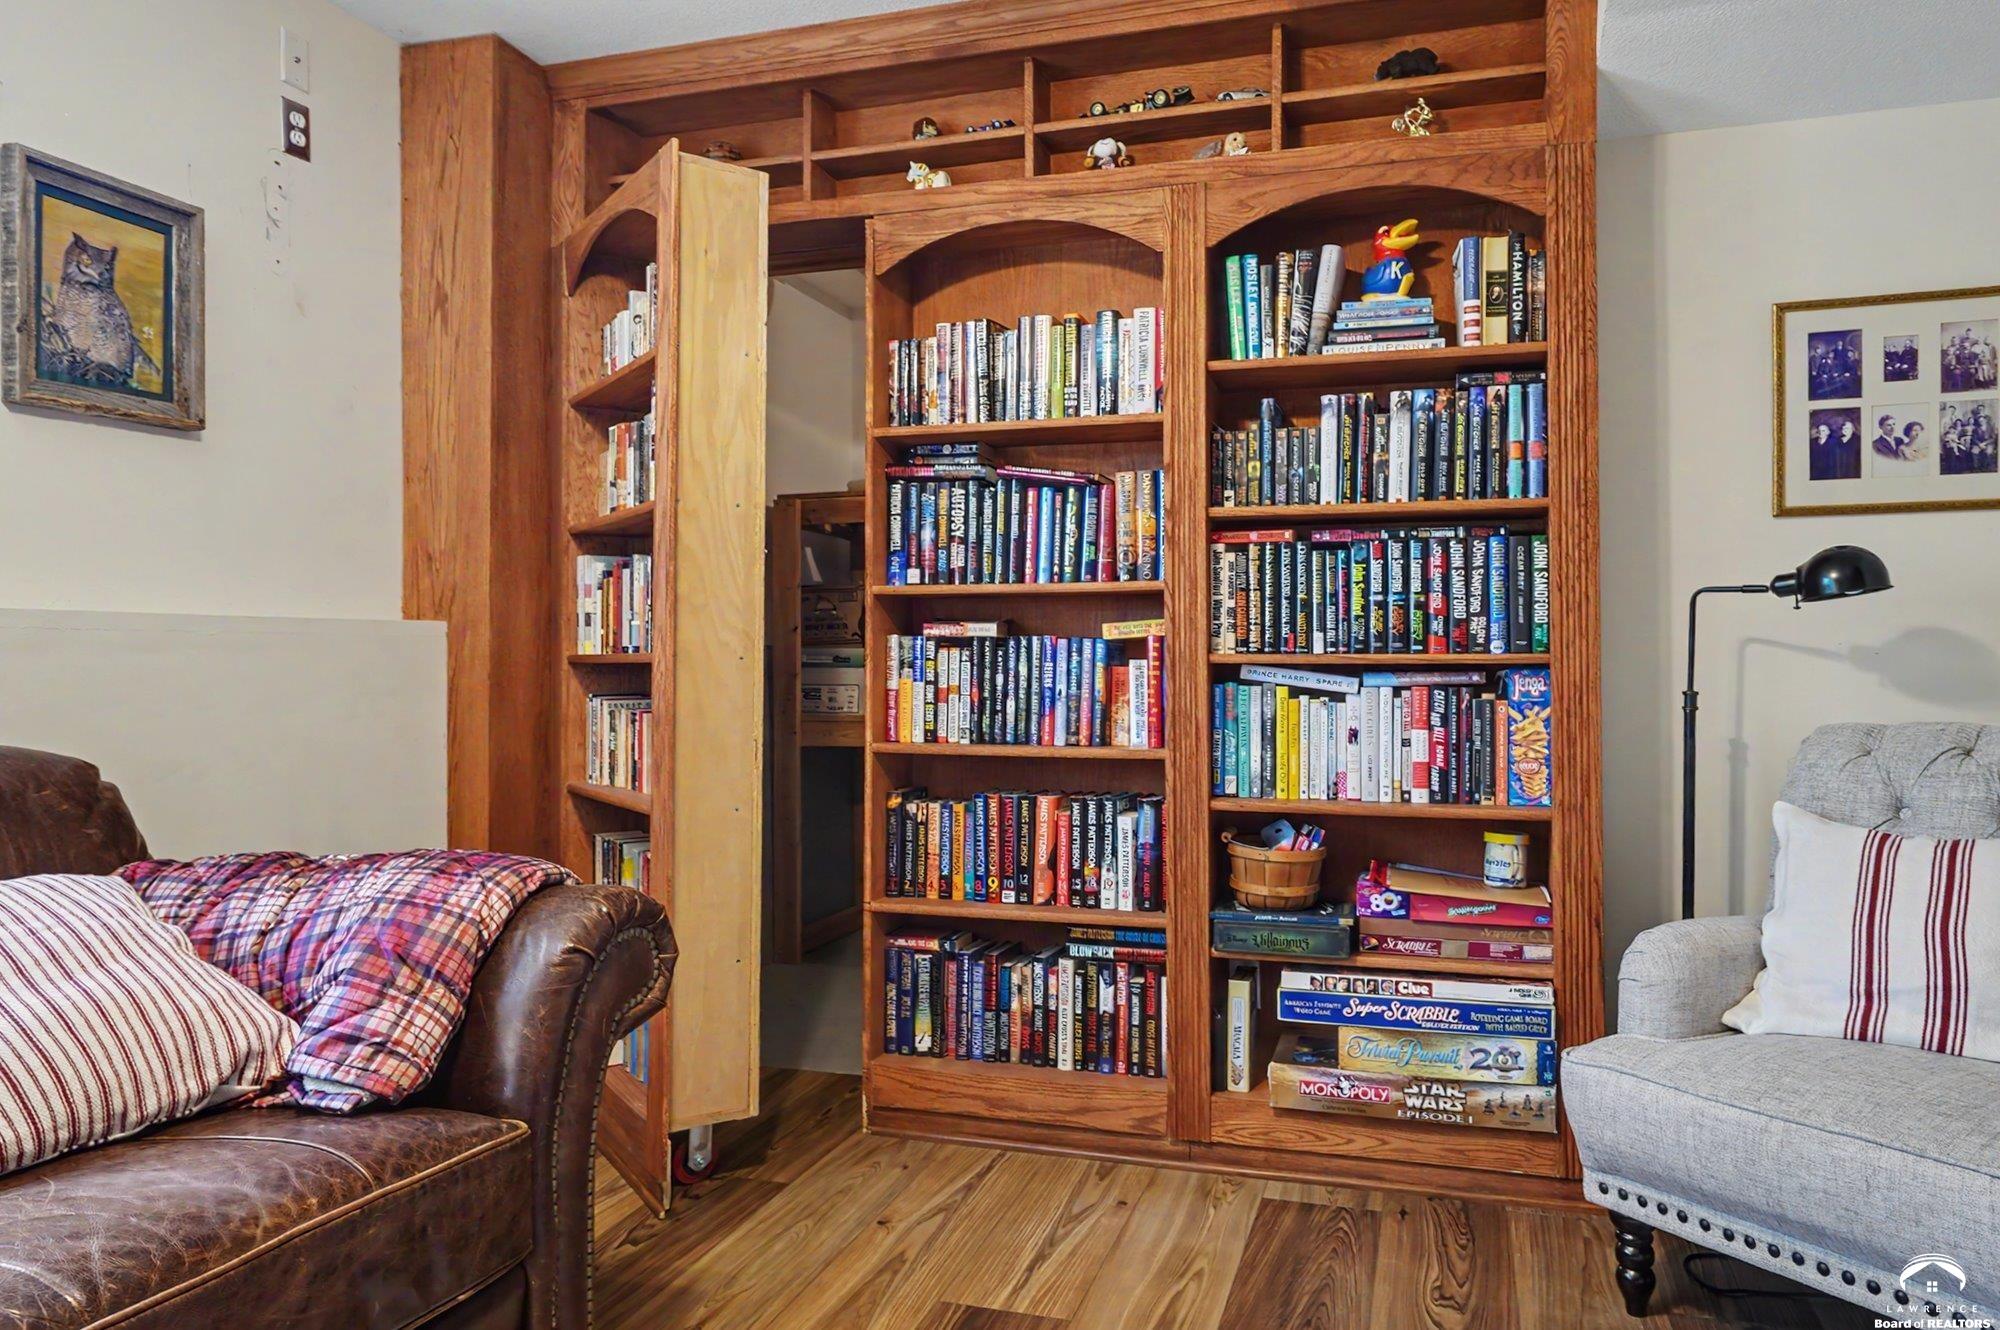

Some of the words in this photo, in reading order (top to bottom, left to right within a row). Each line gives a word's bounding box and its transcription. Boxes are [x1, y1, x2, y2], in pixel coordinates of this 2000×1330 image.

[1391, 262, 1403, 279] K
[1512, 252, 1523, 321] HAMILTON
[1138, 310, 1151, 343] PATRICIA
[951, 487, 966, 537] AUTOPSY
[1433, 543, 1442, 565] JOHN
[1449, 541, 1464, 568] JOHN
[1472, 540, 1486, 567] JOHN
[1492, 541, 1505, 568] JOHN
[1534, 541, 1548, 568] JOHN
[1353, 564, 1366, 581] John
[1353, 583, 1366, 616] Sandford
[1432, 567, 1443, 609] SANDFORD
[1453, 569, 1466, 619] SANDFORD
[1470, 569, 1484, 613] SANDFORD
[1491, 569, 1505, 618] SANDFORD
[1534, 571, 1548, 623] SANDFORD
[1281, 674, 1310, 683] HARRY
[1315, 678, 1343, 687] SPARE
[1511, 674, 1548, 700] Jenga
[1433, 689, 1445, 714] CATCH
[1432, 727, 1445, 743] KILL
[977, 799, 986, 825] JAMES
[988, 800, 998, 826] JAMES
[1005, 799, 1014, 826] JAMES
[1072, 802, 1080, 825] JAMES
[1087, 801, 1096, 825] JAMES
[977, 826, 986, 876] PATTERSON
[988, 827, 998, 876] PATTERSON
[1005, 827, 1015, 877] PATTERSON
[1020, 824, 1029, 867] PATTERSON
[1072, 827, 1081, 870] PATTERSON
[1087, 825, 1096, 869] PATTERSON
[1121, 850, 1130, 888] PATTERSON
[974, 880, 983, 890] 8
[987, 877, 999, 893] 9
[1003, 879, 1014, 890] 10
[1251, 931, 1310, 952] Villainous
[1383, 937, 1437, 954] SCRABBLE
[1397, 980, 1430, 995] Clue
[1342, 997, 1388, 1017] Super
[1383, 1001, 1462, 1024] SCRABBLE
[1485, 1023, 1503, 1032] WITH
[1347, 1035, 1401, 1059] Trivial
[1396, 1037, 1461, 1068] Pursuit
[1470, 1047, 1523, 1072] 20
[1300, 1081, 1389, 1102] MONOPOLY
[1403, 1081, 1466, 1099] STAR
[1404, 1094, 1467, 1113] WARS
[1397, 1109, 1464, 1123] EPISODE
[1468, 1114, 1474, 1124] I
